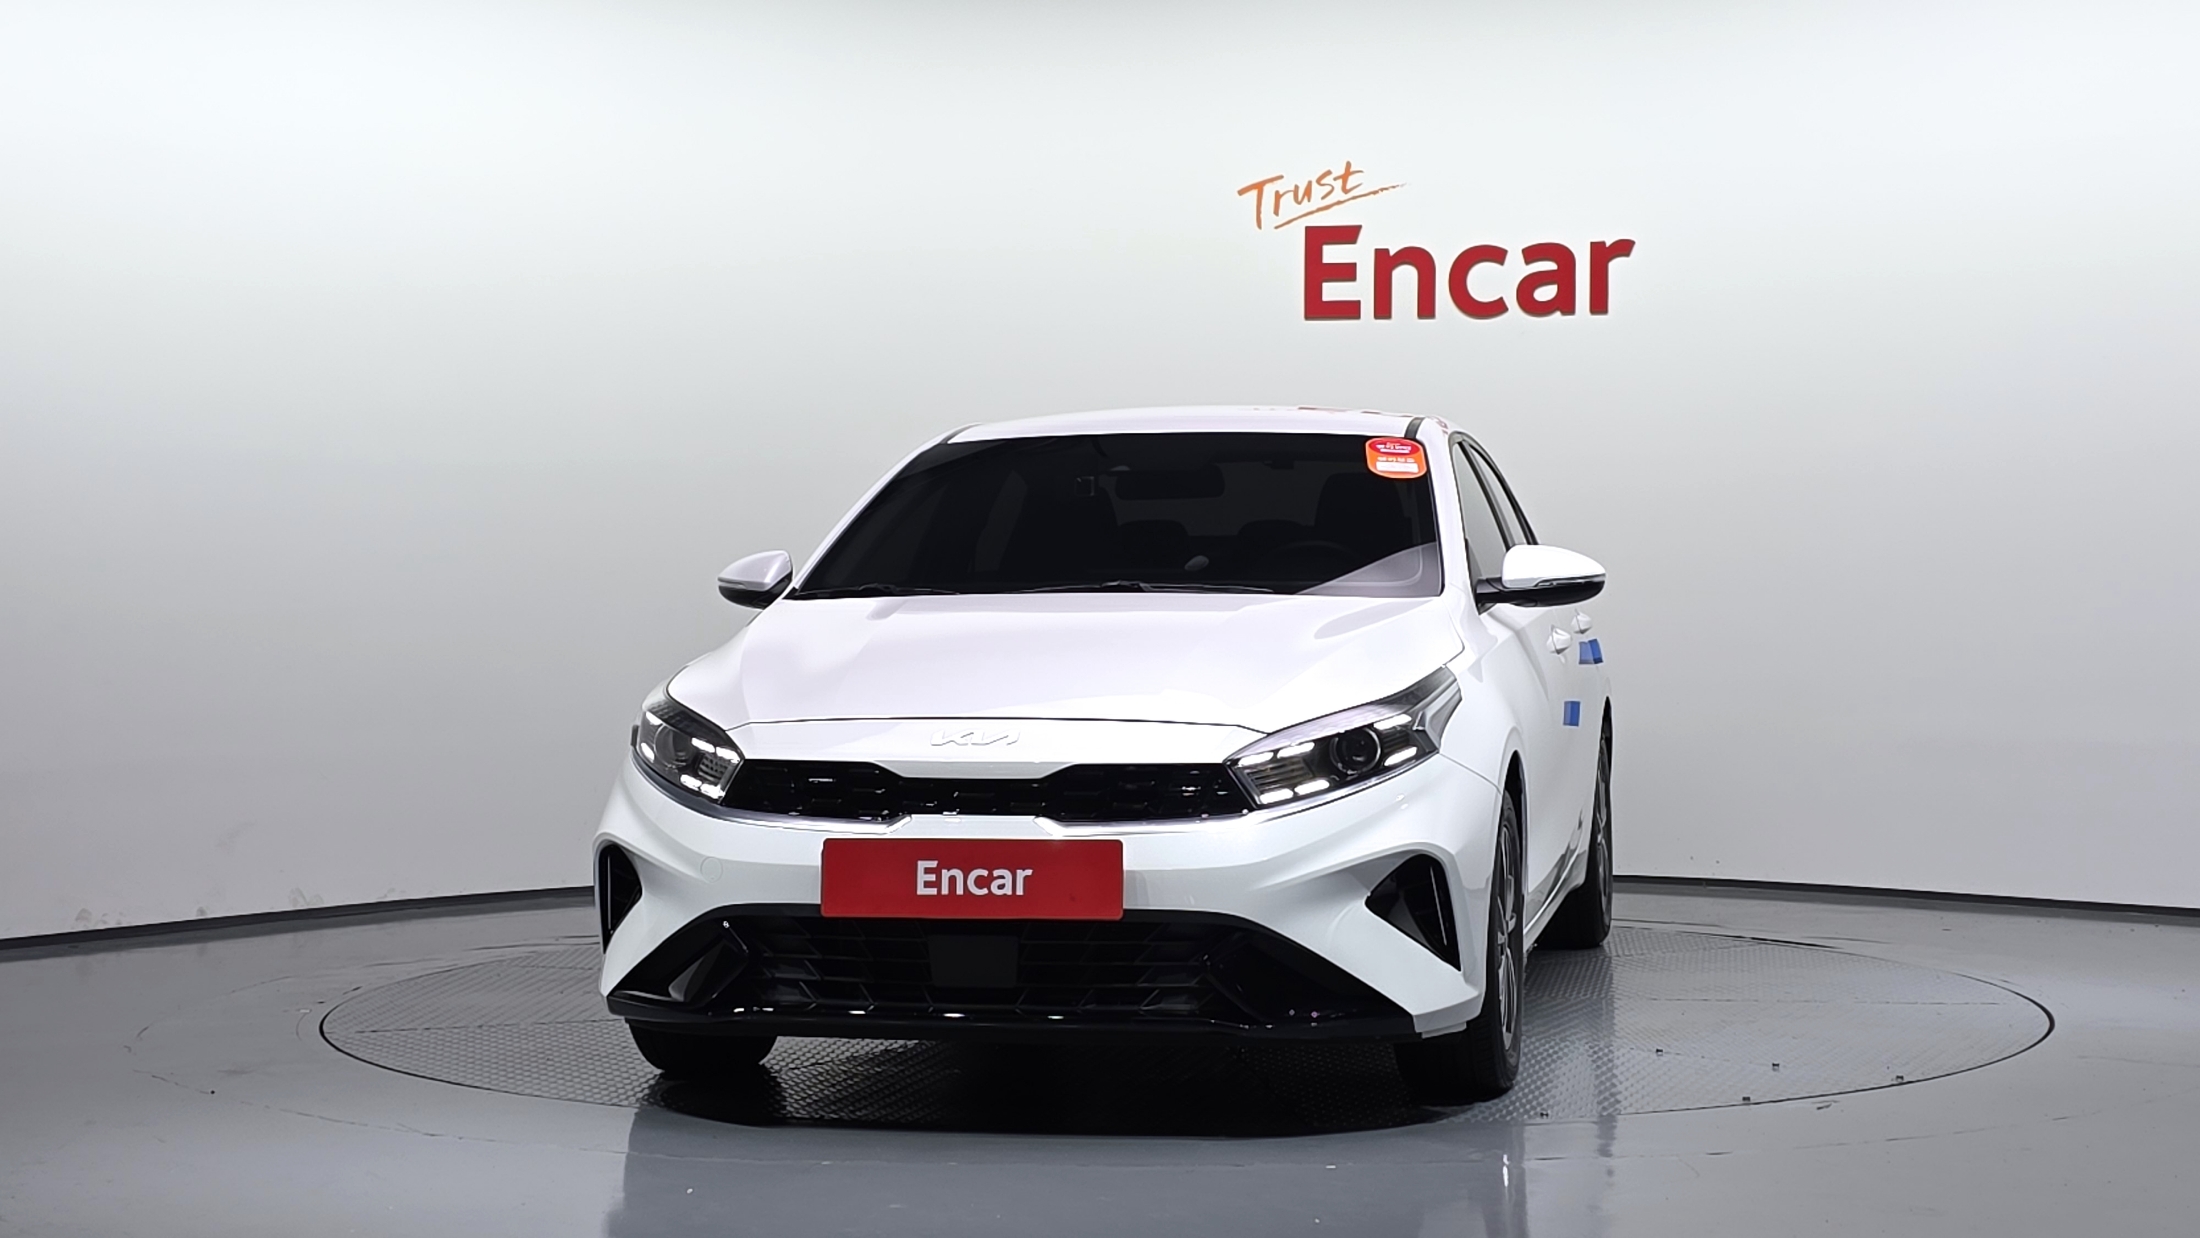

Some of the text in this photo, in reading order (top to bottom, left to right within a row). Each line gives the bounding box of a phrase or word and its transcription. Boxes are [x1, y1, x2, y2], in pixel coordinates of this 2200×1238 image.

[1237, 161, 1365, 230] Trust
[1304, 225, 1636, 320] Encar
[916, 860, 1033, 896] Encar
